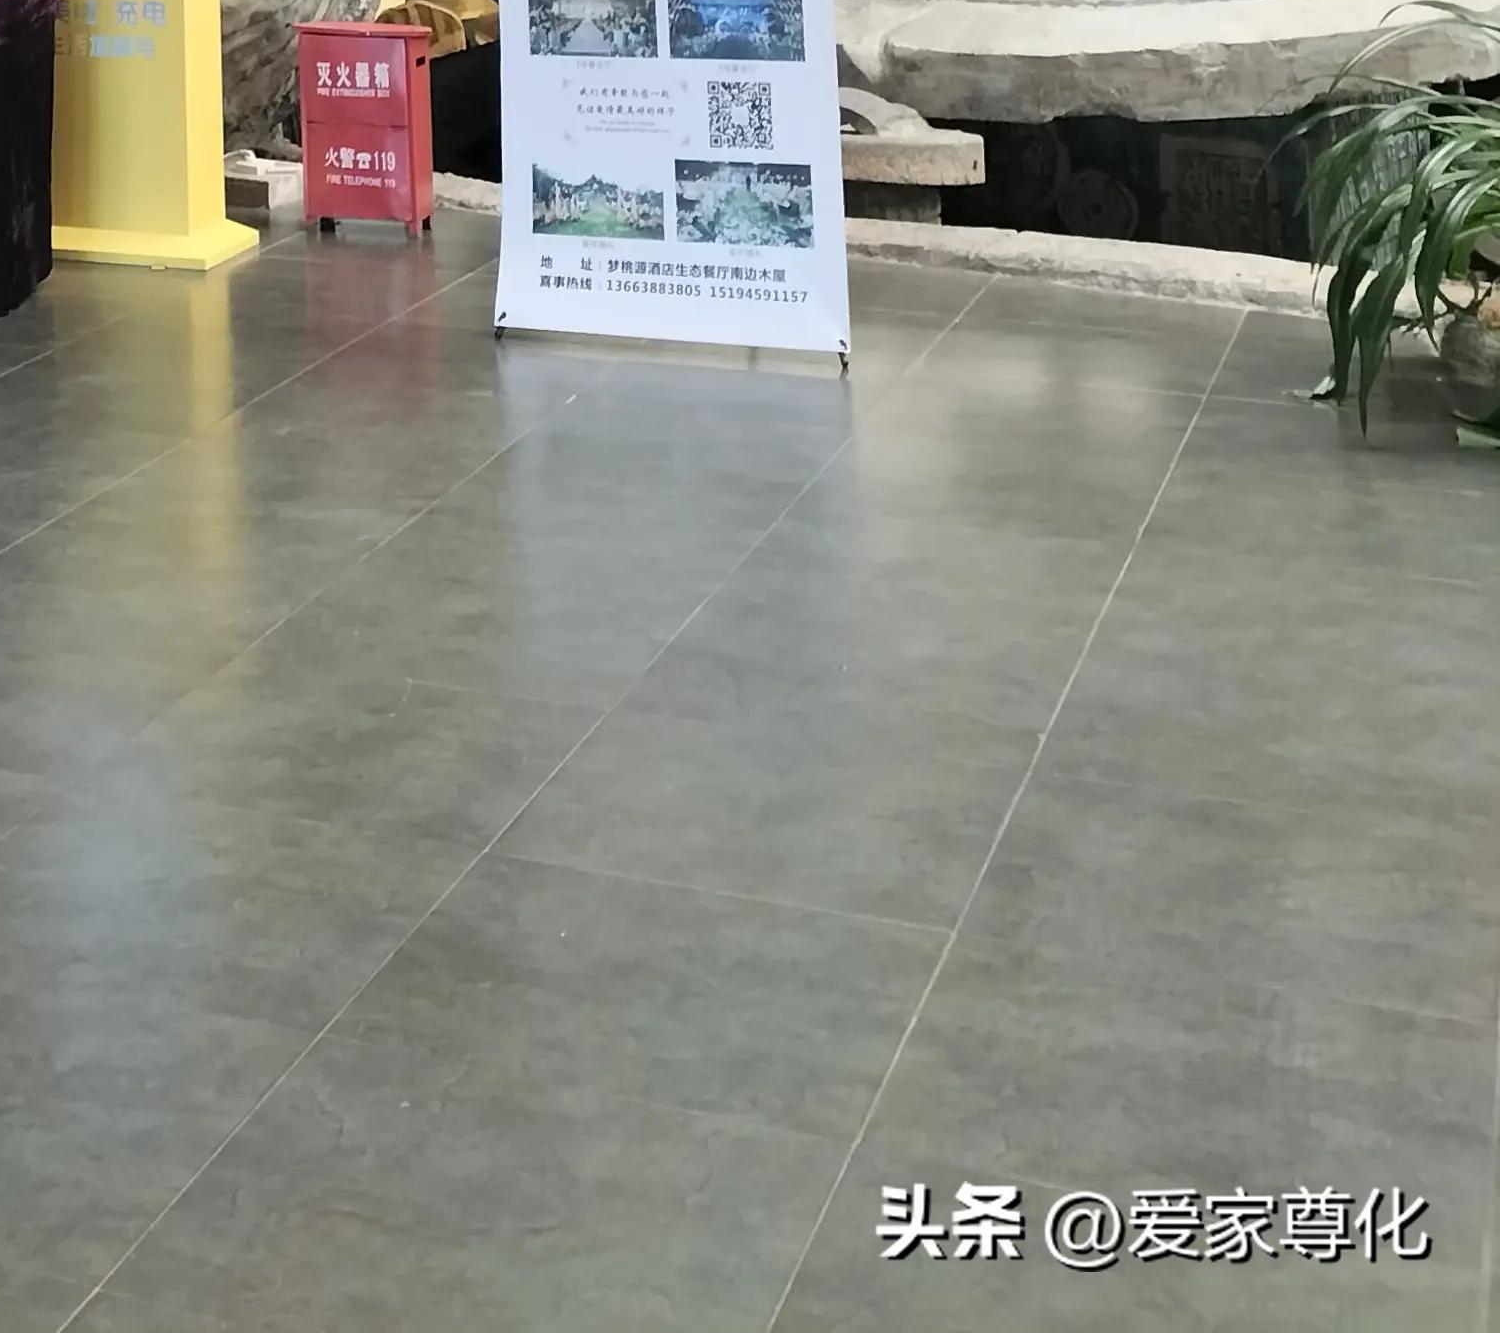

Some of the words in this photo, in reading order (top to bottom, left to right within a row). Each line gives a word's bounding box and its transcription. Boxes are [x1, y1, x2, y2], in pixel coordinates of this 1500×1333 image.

[316, 61, 390, 89] 灭火器箱
[607, 259, 787, 283] 梦桃源酒店生态餐厅南边木屋
[606, 279, 702, 298] 13663883805
[709, 285, 809, 305] 15194591157
